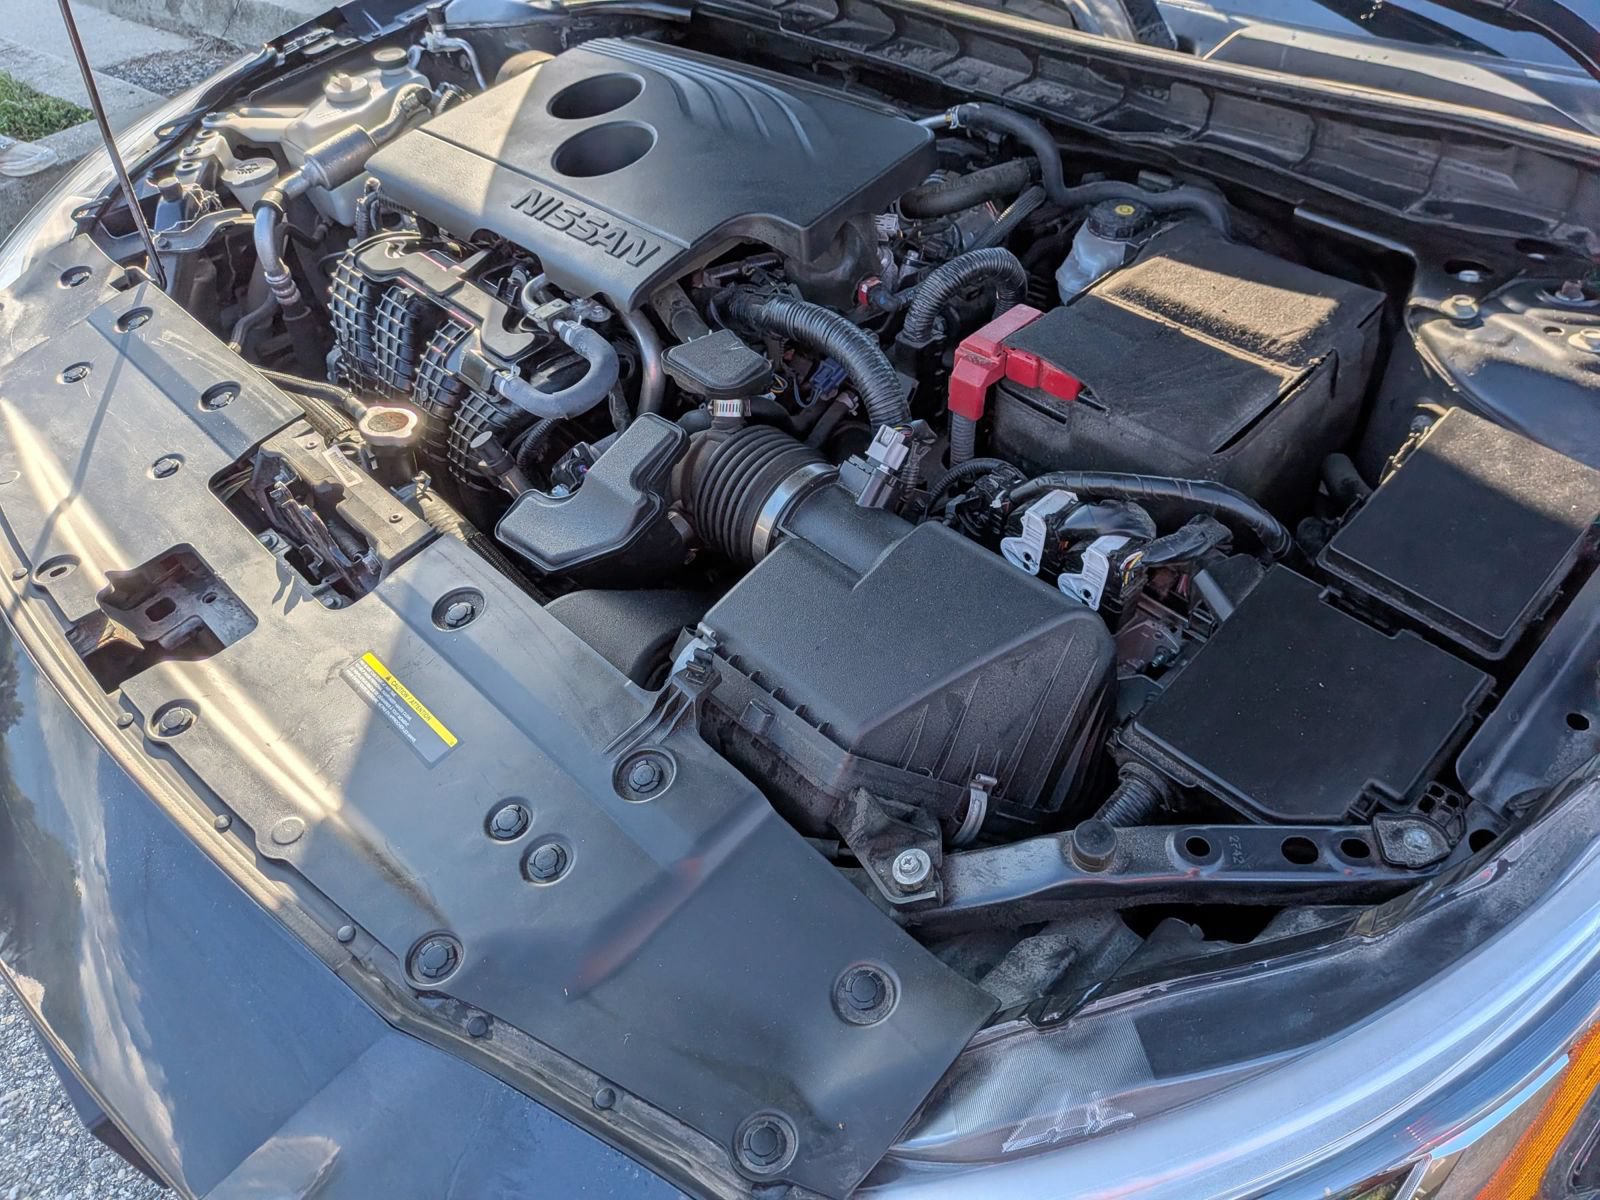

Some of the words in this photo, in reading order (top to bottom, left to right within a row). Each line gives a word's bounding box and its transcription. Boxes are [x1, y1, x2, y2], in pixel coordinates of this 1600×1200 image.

[510, 187, 661, 267] NISSAN
[390, 680, 408, 699] CAUTION
[410, 699, 432, 721] ATTENTION
